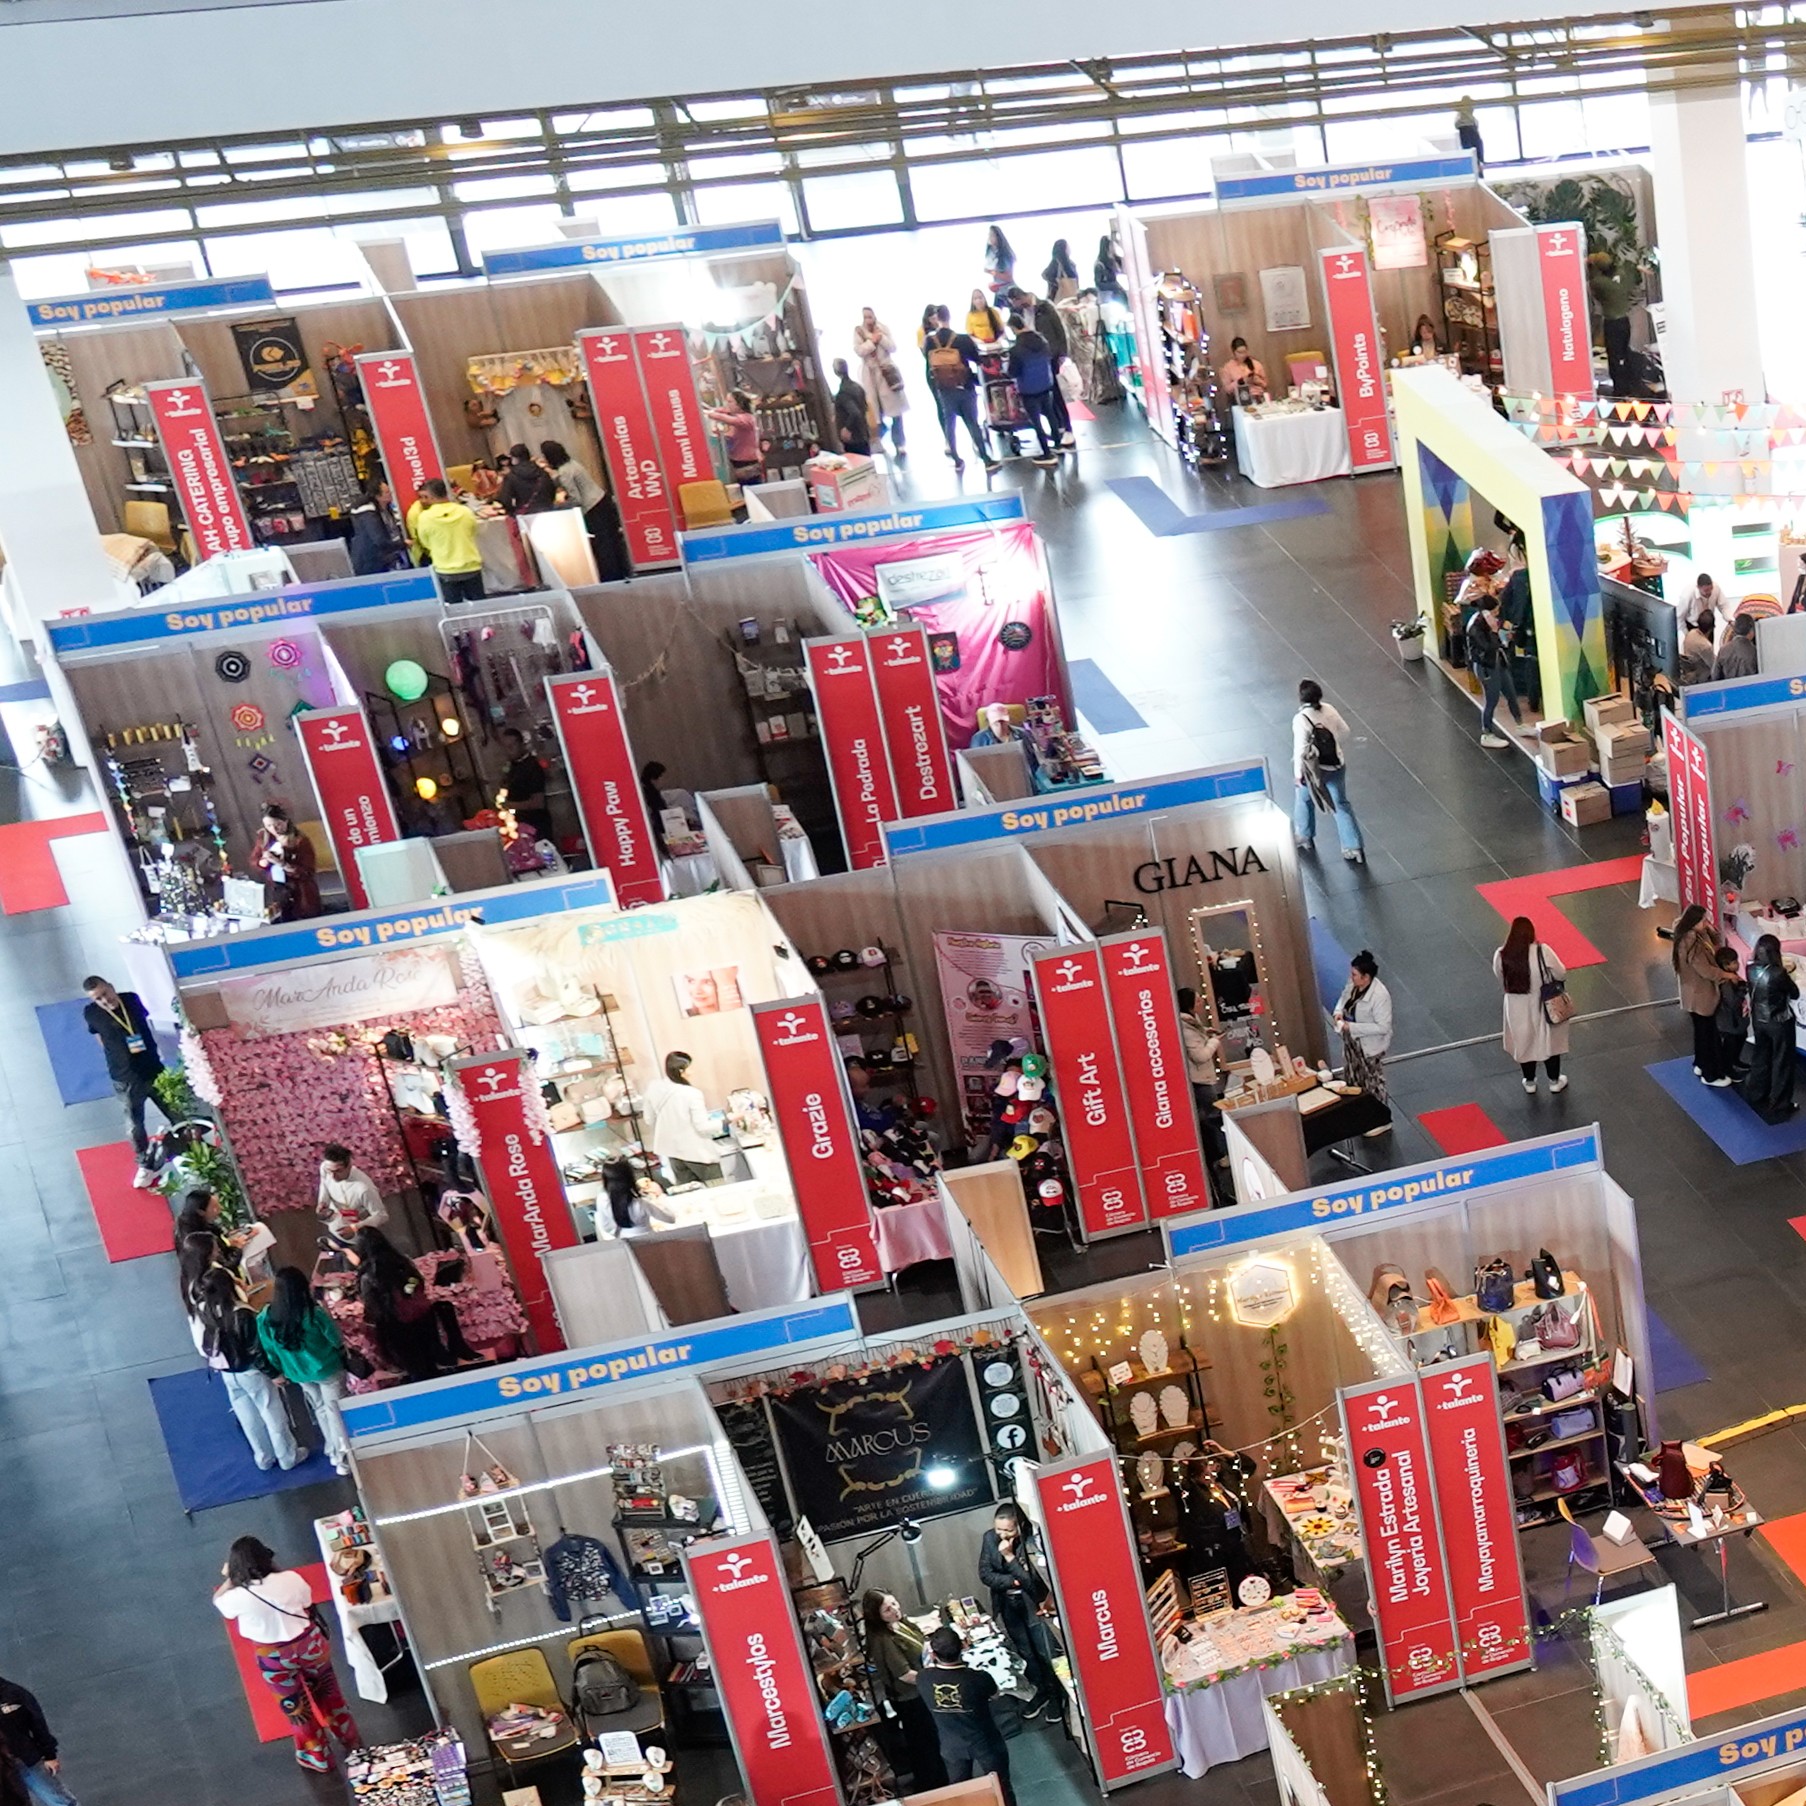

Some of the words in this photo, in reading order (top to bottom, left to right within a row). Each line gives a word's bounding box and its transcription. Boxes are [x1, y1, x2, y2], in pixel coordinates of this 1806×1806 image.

[1295, 174, 1327, 189] Soy
[1329, 167, 1392, 187] popular
[582, 244, 619, 260] Soy
[624, 236, 695, 258] popular
[37, 303, 79, 321] Soy
[85, 295, 165, 320] popular
[1355, 333, 1374, 399] ByPoints
[670, 389, 691, 439] Mauss
[681, 442, 699, 478] Mami
[793, 525, 837, 543] Soy
[841, 514, 924, 540] popular
[167, 612, 214, 631] Soy
[219, 596, 313, 627] popular
[603, 781, 621, 815] Paw
[865, 799, 881, 825] La
[1002, 811, 1051, 830] Soy
[1054, 792, 1146, 823] popular
[608, 821, 635, 867] Happy
[1132, 844, 1269, 894] GIANA
[316, 926, 371, 948] Soy
[377, 905, 484, 942] popular
[1138, 989, 1170, 1081] accesorios
[1077, 1052, 1099, 1086] Art
[811, 1093, 834, 1159] Grazie
[1084, 1087, 1107, 1127] Gift
[1154, 1085, 1173, 1130] Giana
[1312, 1195, 1366, 1217] Soy
[1370, 1167, 1474, 1205] popular
[499, 1373, 560, 1398] Soy
[569, 1344, 691, 1386] popular
[825, 1423, 931, 1463] MARCUS
[1373, 1468, 1397, 1537] Estrada
[1382, 1538, 1408, 1603] Marilyn
[1096, 1589, 1118, 1661] Marcus
[745, 1632, 791, 1750] Marcestylos
[1719, 1734, 1778, 1766] Soy
